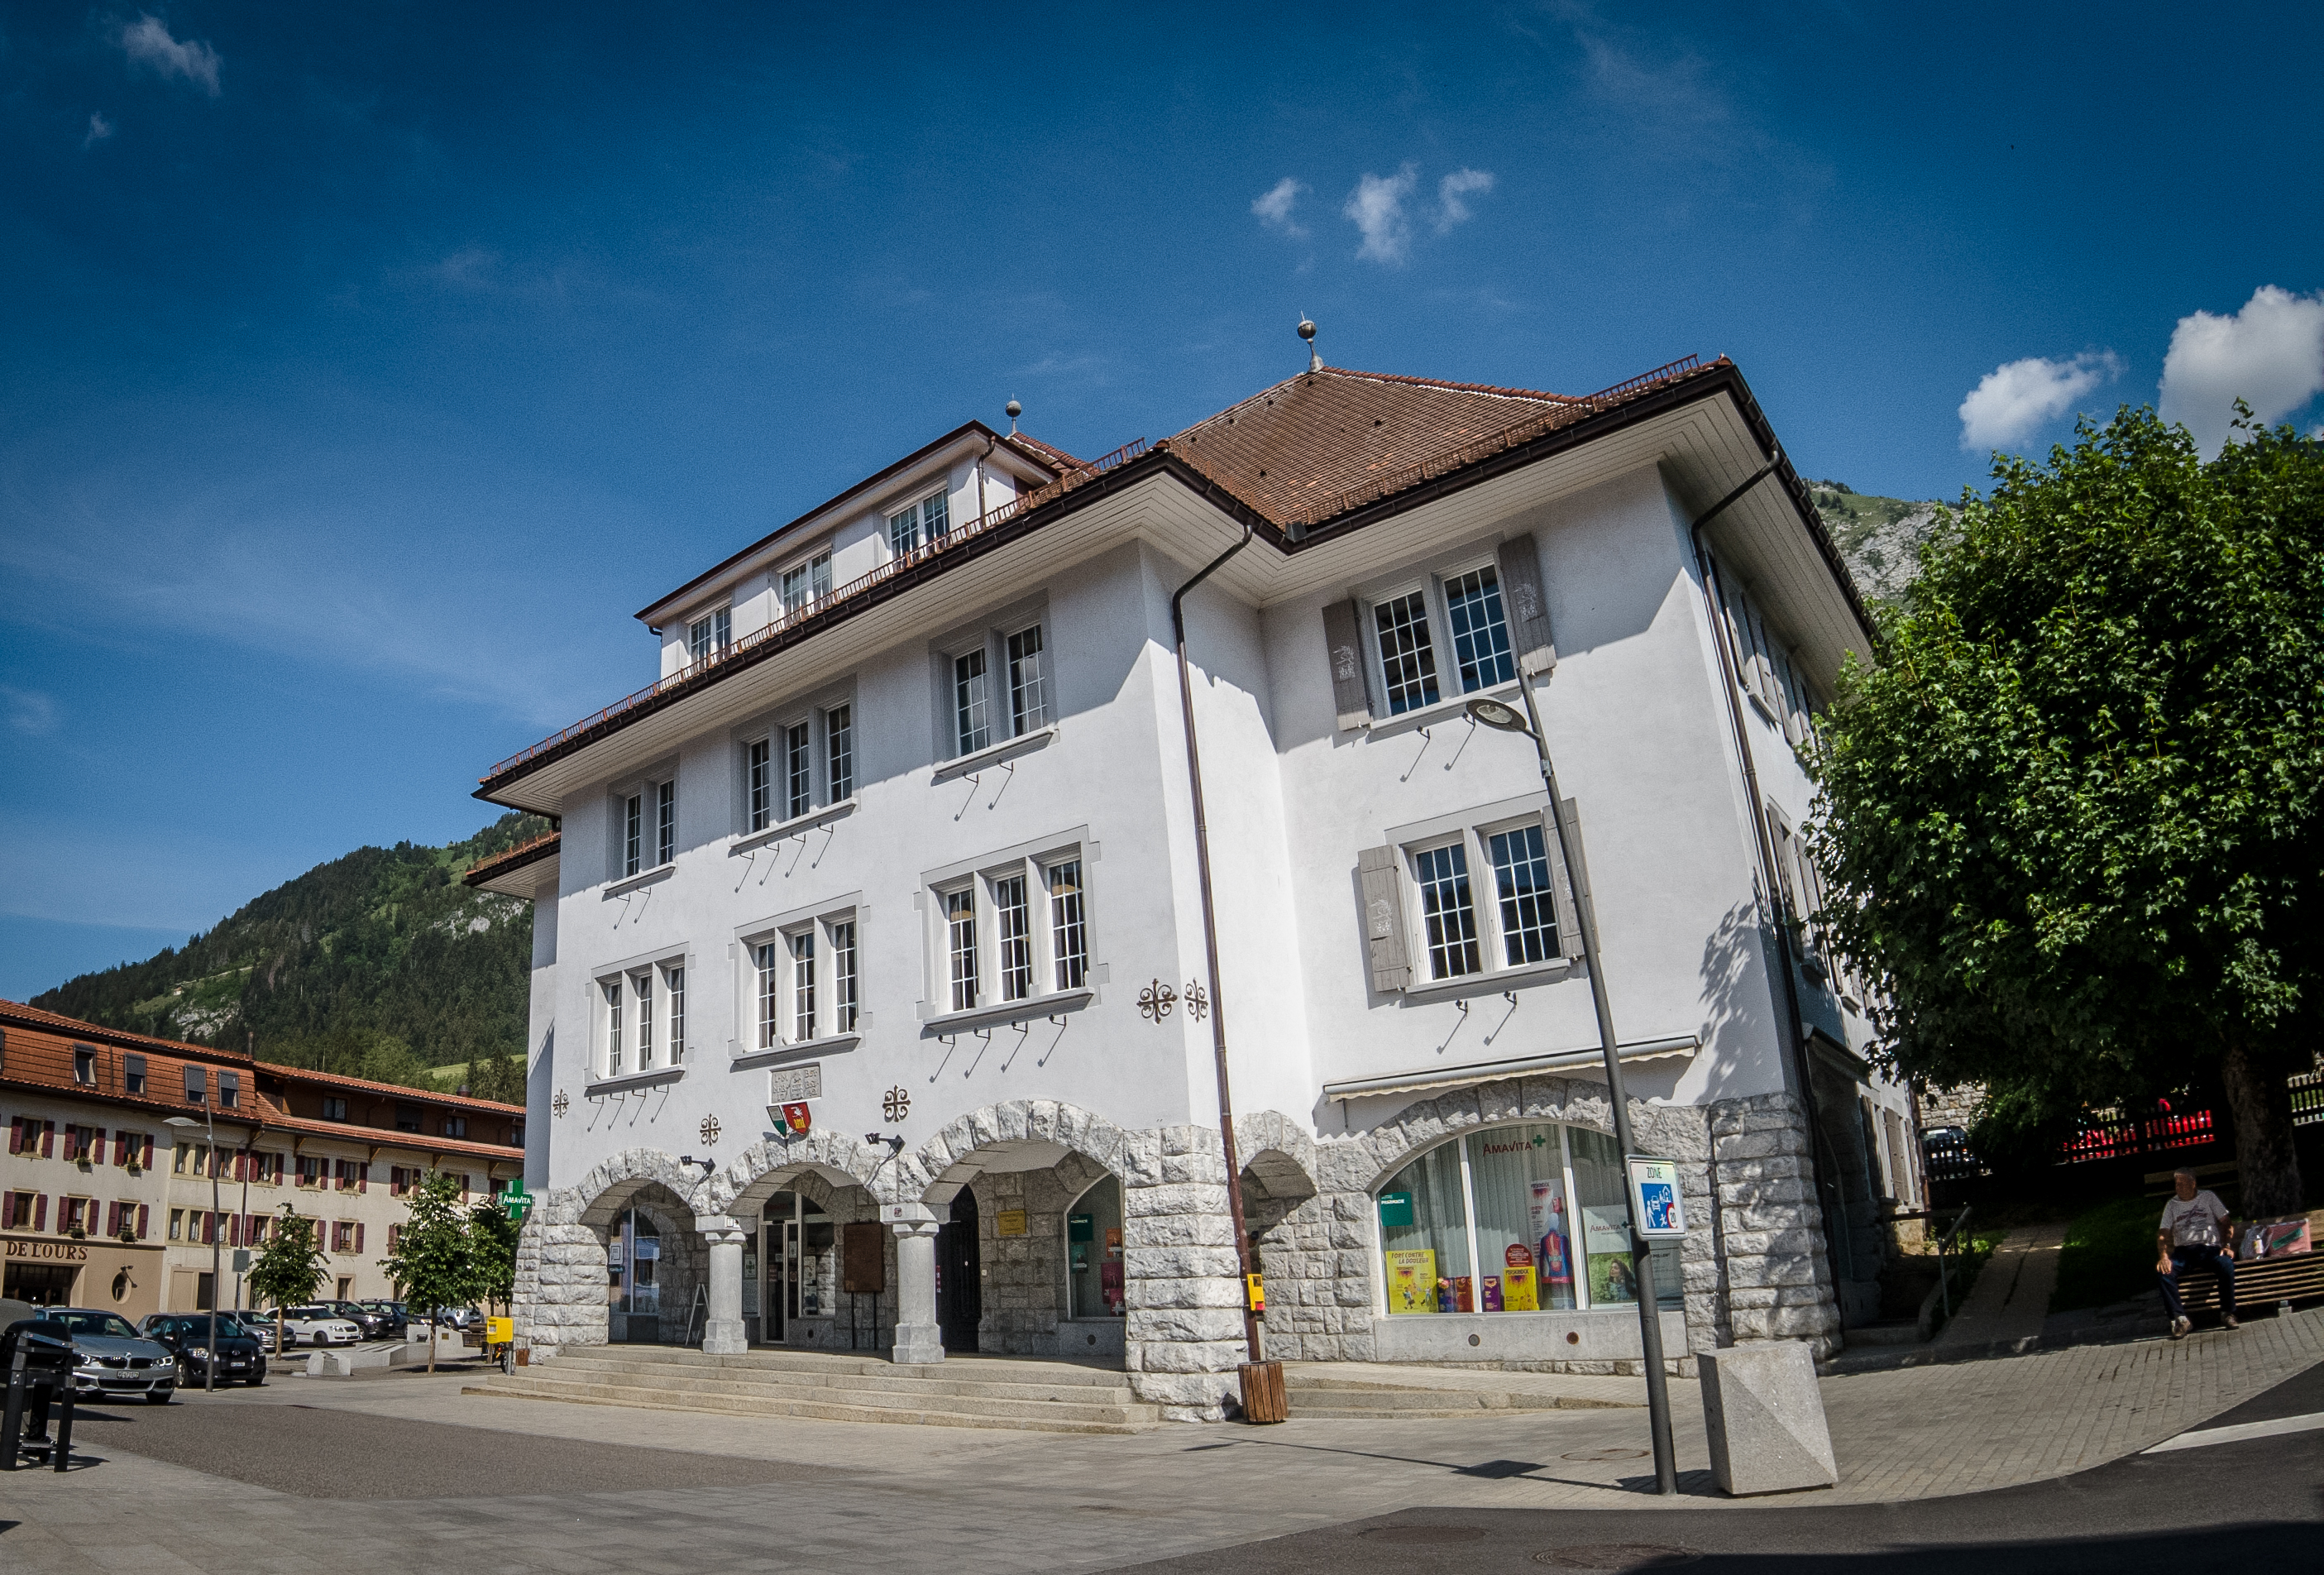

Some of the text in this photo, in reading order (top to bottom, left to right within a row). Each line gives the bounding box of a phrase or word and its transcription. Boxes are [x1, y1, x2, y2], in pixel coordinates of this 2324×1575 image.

[1483, 1141, 1533, 1156] AMAVITA
[1646, 1166, 1662, 1179] ZONE
[503, 1194, 531, 1204] AMAVITA
[1670, 1212, 1676, 1223] 20
[1590, 1223, 1621, 1233] AMAVITA
[6, 1241, 88, 1260] DE L'OURS
